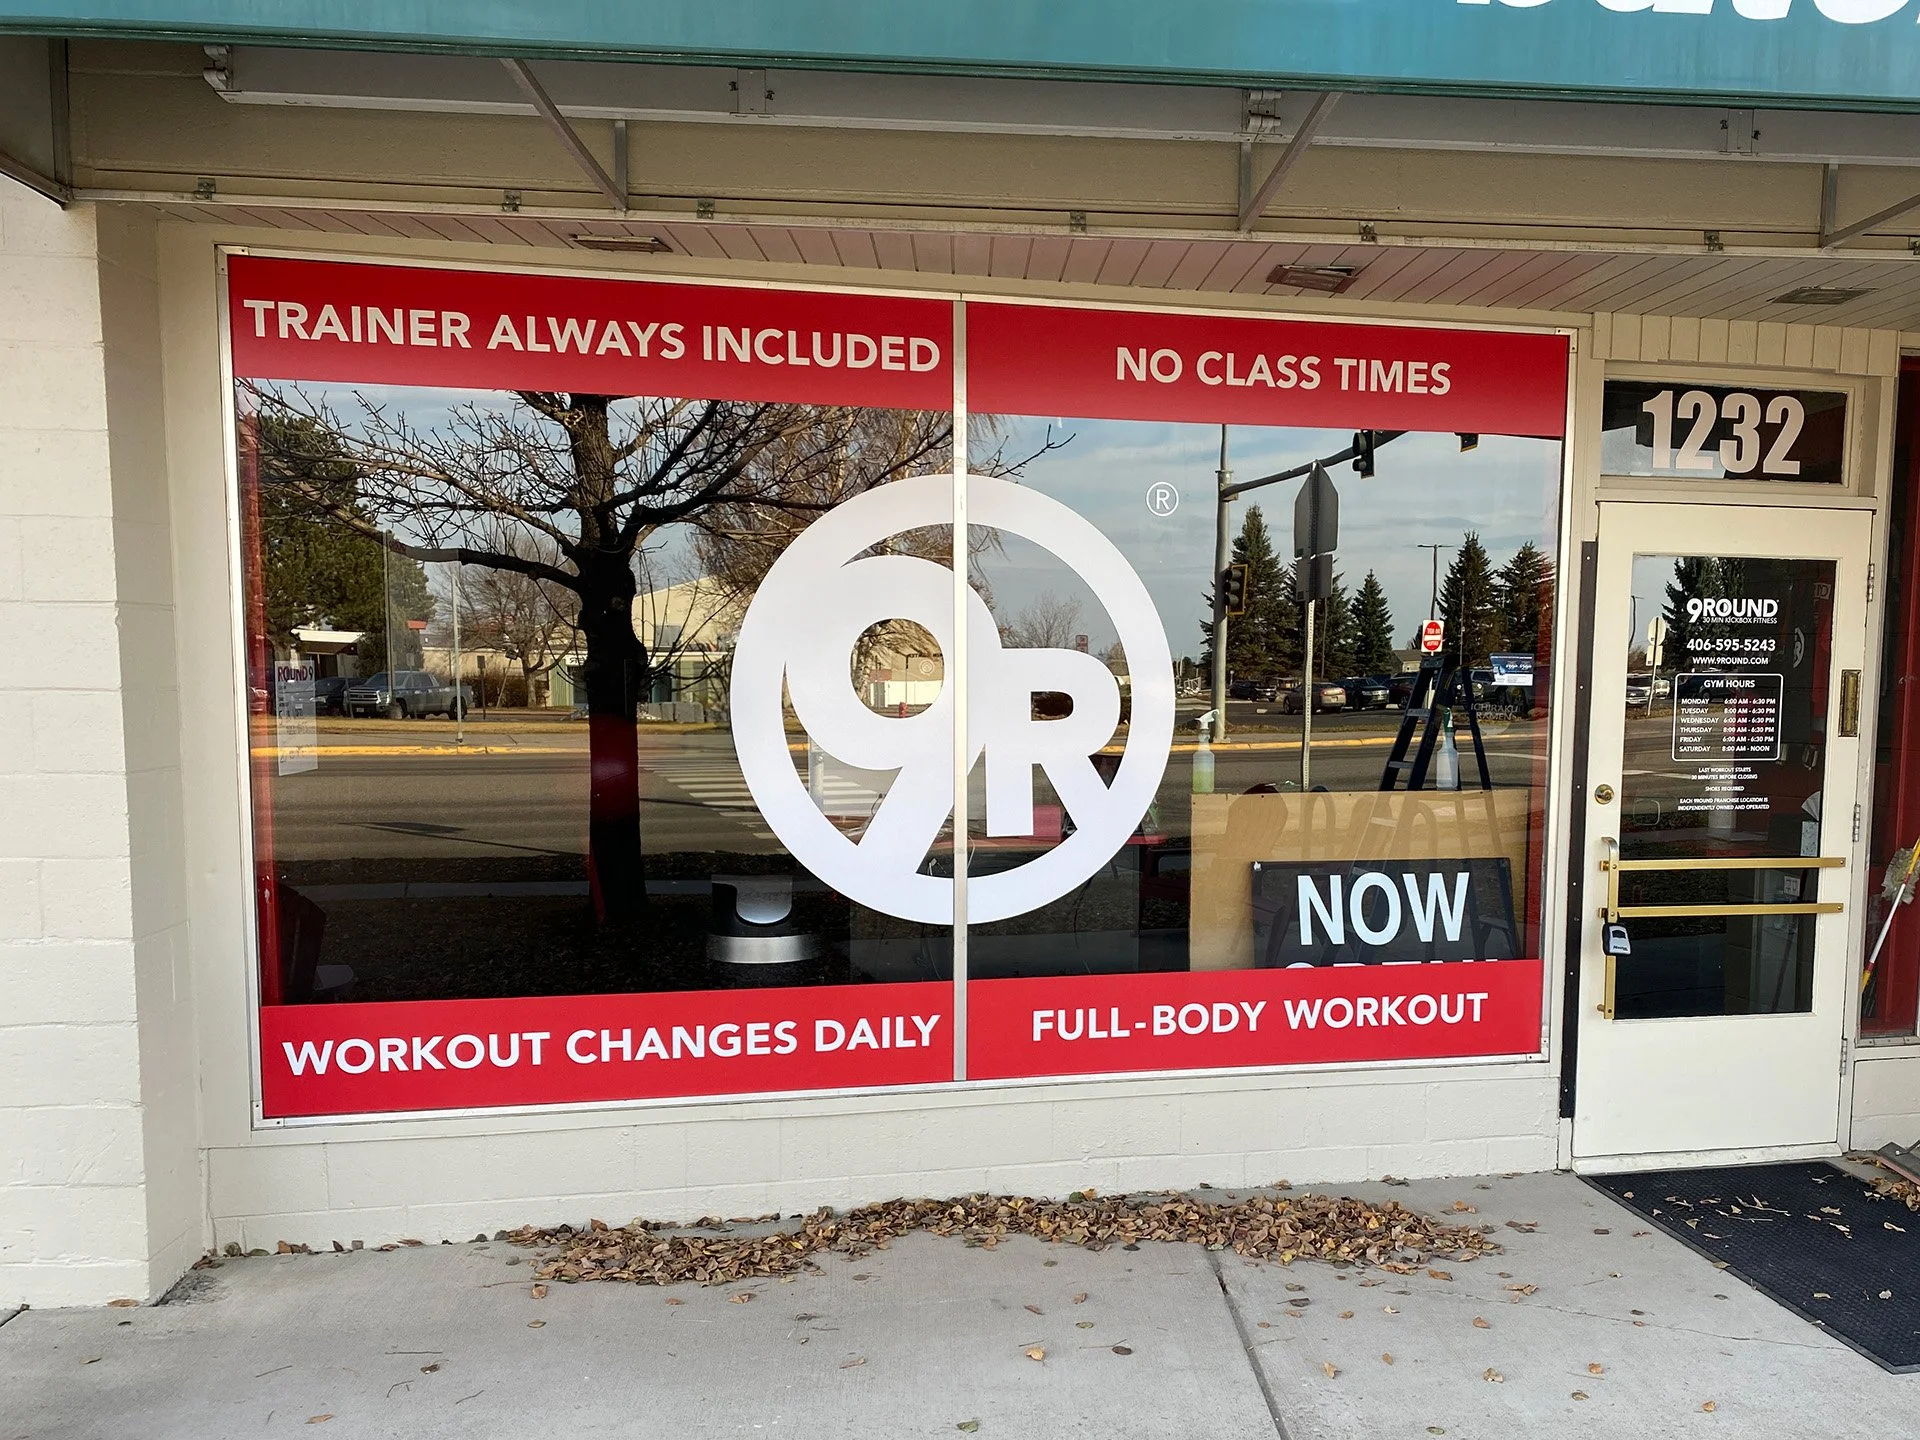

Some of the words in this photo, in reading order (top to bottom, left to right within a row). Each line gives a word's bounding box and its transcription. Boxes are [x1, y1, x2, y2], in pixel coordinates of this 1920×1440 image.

[243, 299, 472, 349] TRAINER
[486, 314, 686, 360] ALWAYS
[702, 325, 941, 373] INCLUDED
[1115, 346, 1183, 384] NO
[1196, 350, 1321, 390] CLASS
[1333, 357, 1451, 395] TIMES
[1642, 389, 1805, 475] 1232
[1686, 597, 1778, 624] 9ROUND
[1686, 638, 1776, 651] 406-595-5243
[1692, 656, 1769, 664] WWW.9ROUND.COM
[277, 665, 308, 682] ROUND
[308, 665, 314, 681] 9
[1704, 680, 1724, 688] GYM
[1726, 680, 1756, 688] HOURS
[1476, 711, 1512, 720] RAMEN
[1297, 871, 1470, 946] NOW
[1031, 1000, 1267, 1042] FULL-BODY
[1283, 992, 1489, 1030] WORKOUT
[281, 1031, 551, 1076] WORKOUT
[565, 1020, 798, 1065] CHANGES
[814, 1014, 942, 1052] DAILY
